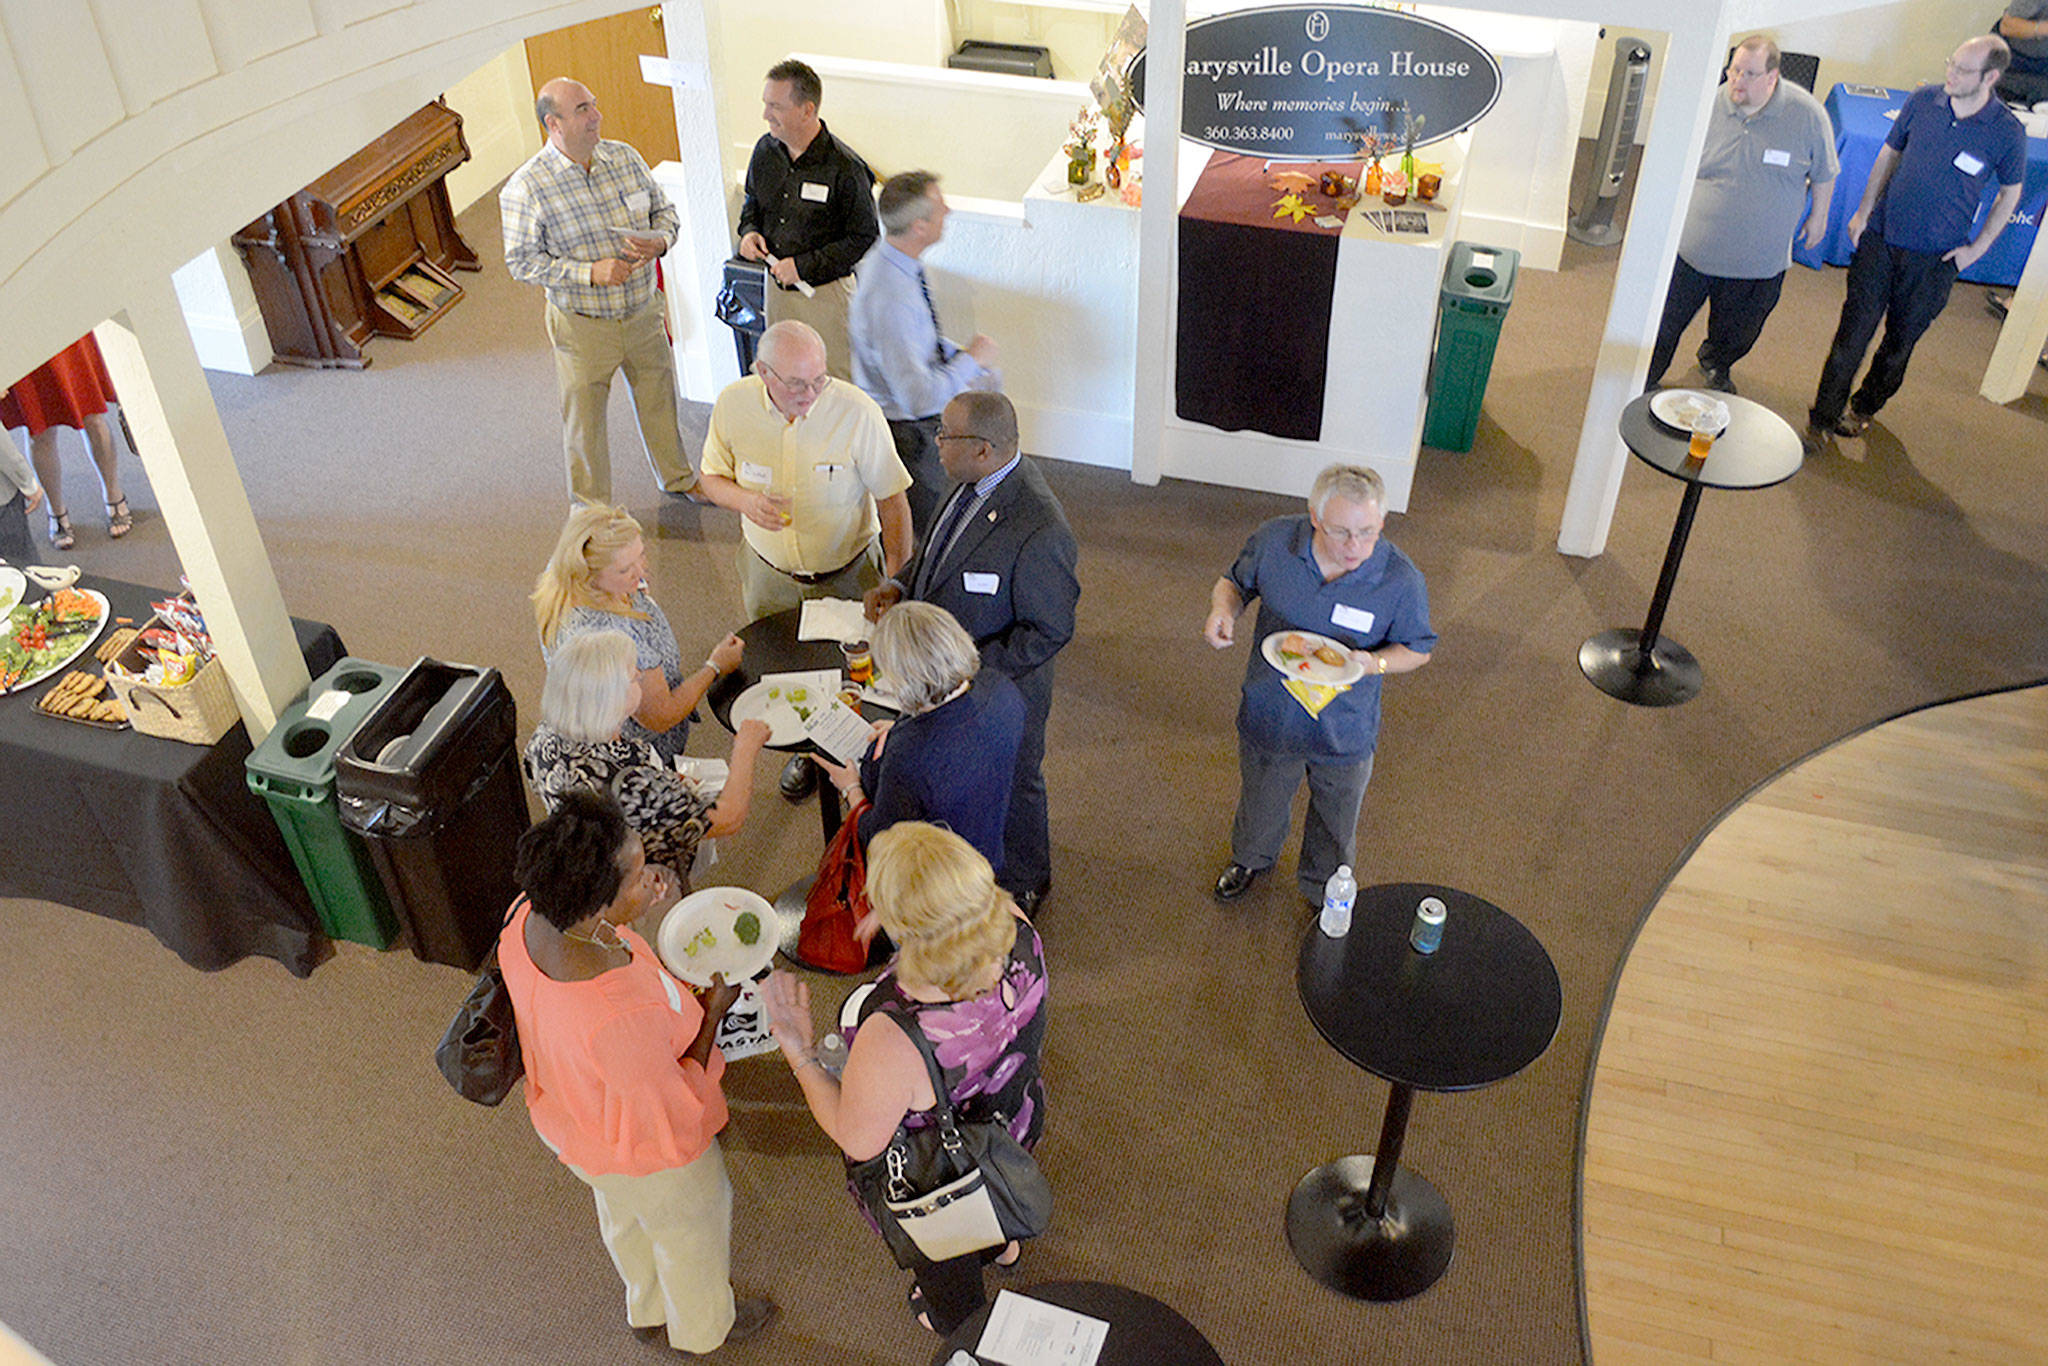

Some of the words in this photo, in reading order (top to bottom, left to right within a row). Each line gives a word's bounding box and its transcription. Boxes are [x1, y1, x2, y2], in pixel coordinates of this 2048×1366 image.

[1184, 46, 1292, 82] arysville
[1301, 50, 1380, 82] Opera
[1389, 51, 1470, 76] House
[1216, 90, 1268, 111] Where
[1272, 97, 1345, 112] memories
[1203, 126, 1295, 140] 360.363.8400
